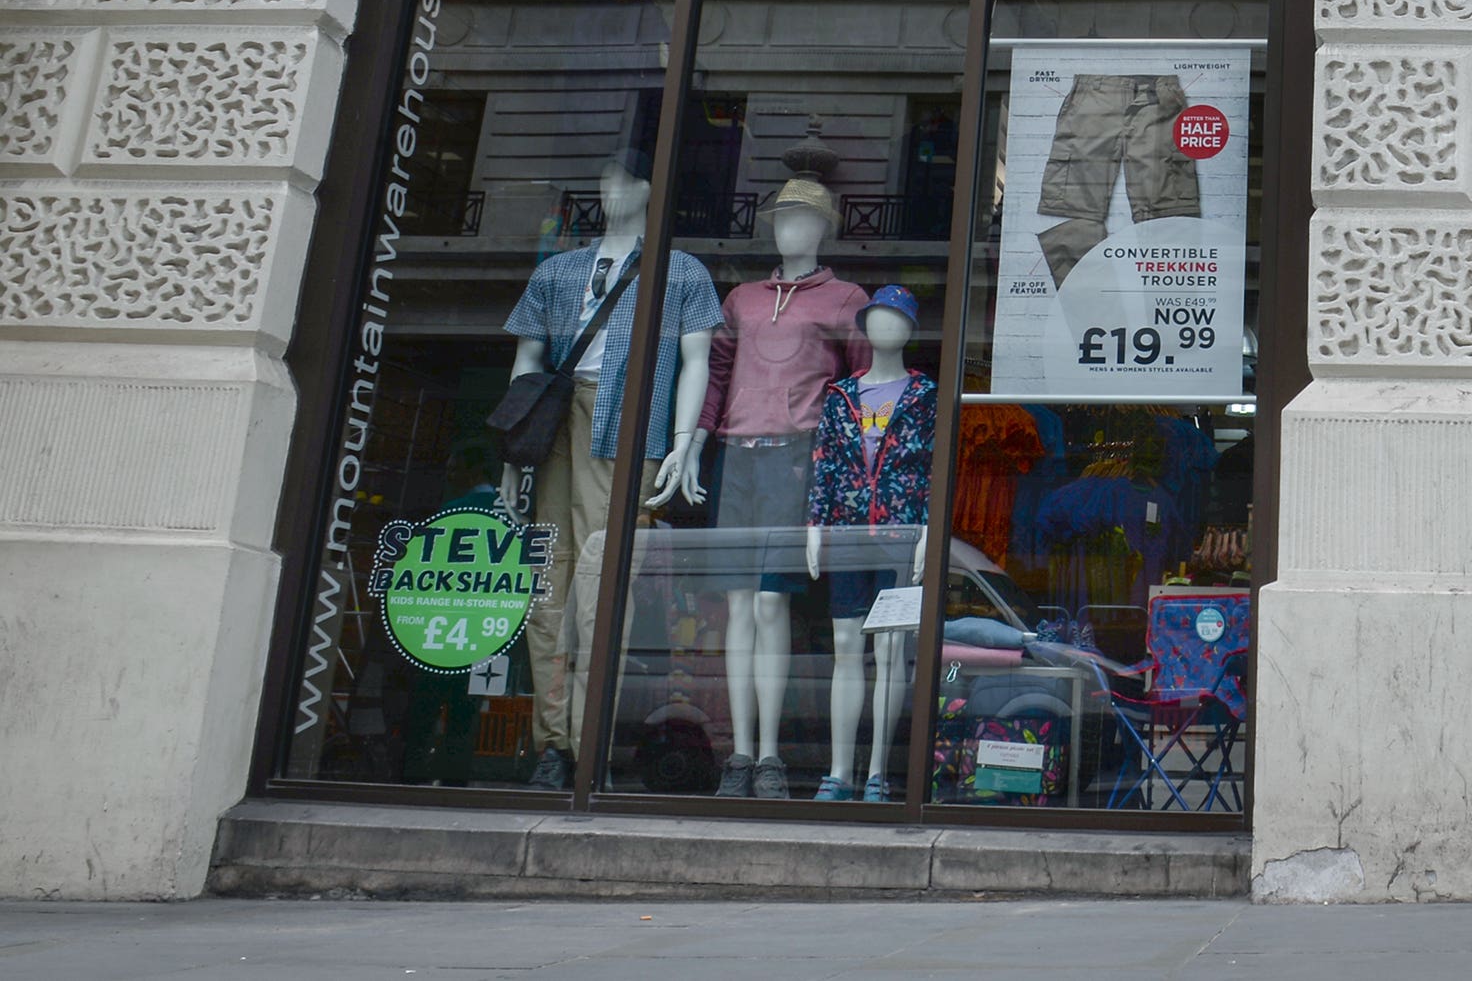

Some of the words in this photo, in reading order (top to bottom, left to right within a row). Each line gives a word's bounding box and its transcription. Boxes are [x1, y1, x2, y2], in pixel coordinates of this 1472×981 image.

[1181, 122, 1222, 135] HALF
[1180, 136, 1221, 148] PRICE
[1103, 248, 1218, 259] CONVERTIBLE
[1135, 262, 1218, 272] TREKKING
[1141, 275, 1217, 286] TROUSER
[1155, 297, 1181, 307] WAS
[1154, 308, 1216, 325] NOW
[1078, 327, 1216, 365] £19.99
[379, 525, 552, 566] STEVE
[373, 568, 547, 595] BACKSHALL
[390, 596, 414, 605] KIDS
[416, 597, 450, 607] RANGE
[453, 598, 497, 608] IN-STORE
[500, 600, 524, 609] NOW
[396, 615, 425, 625] FROM
